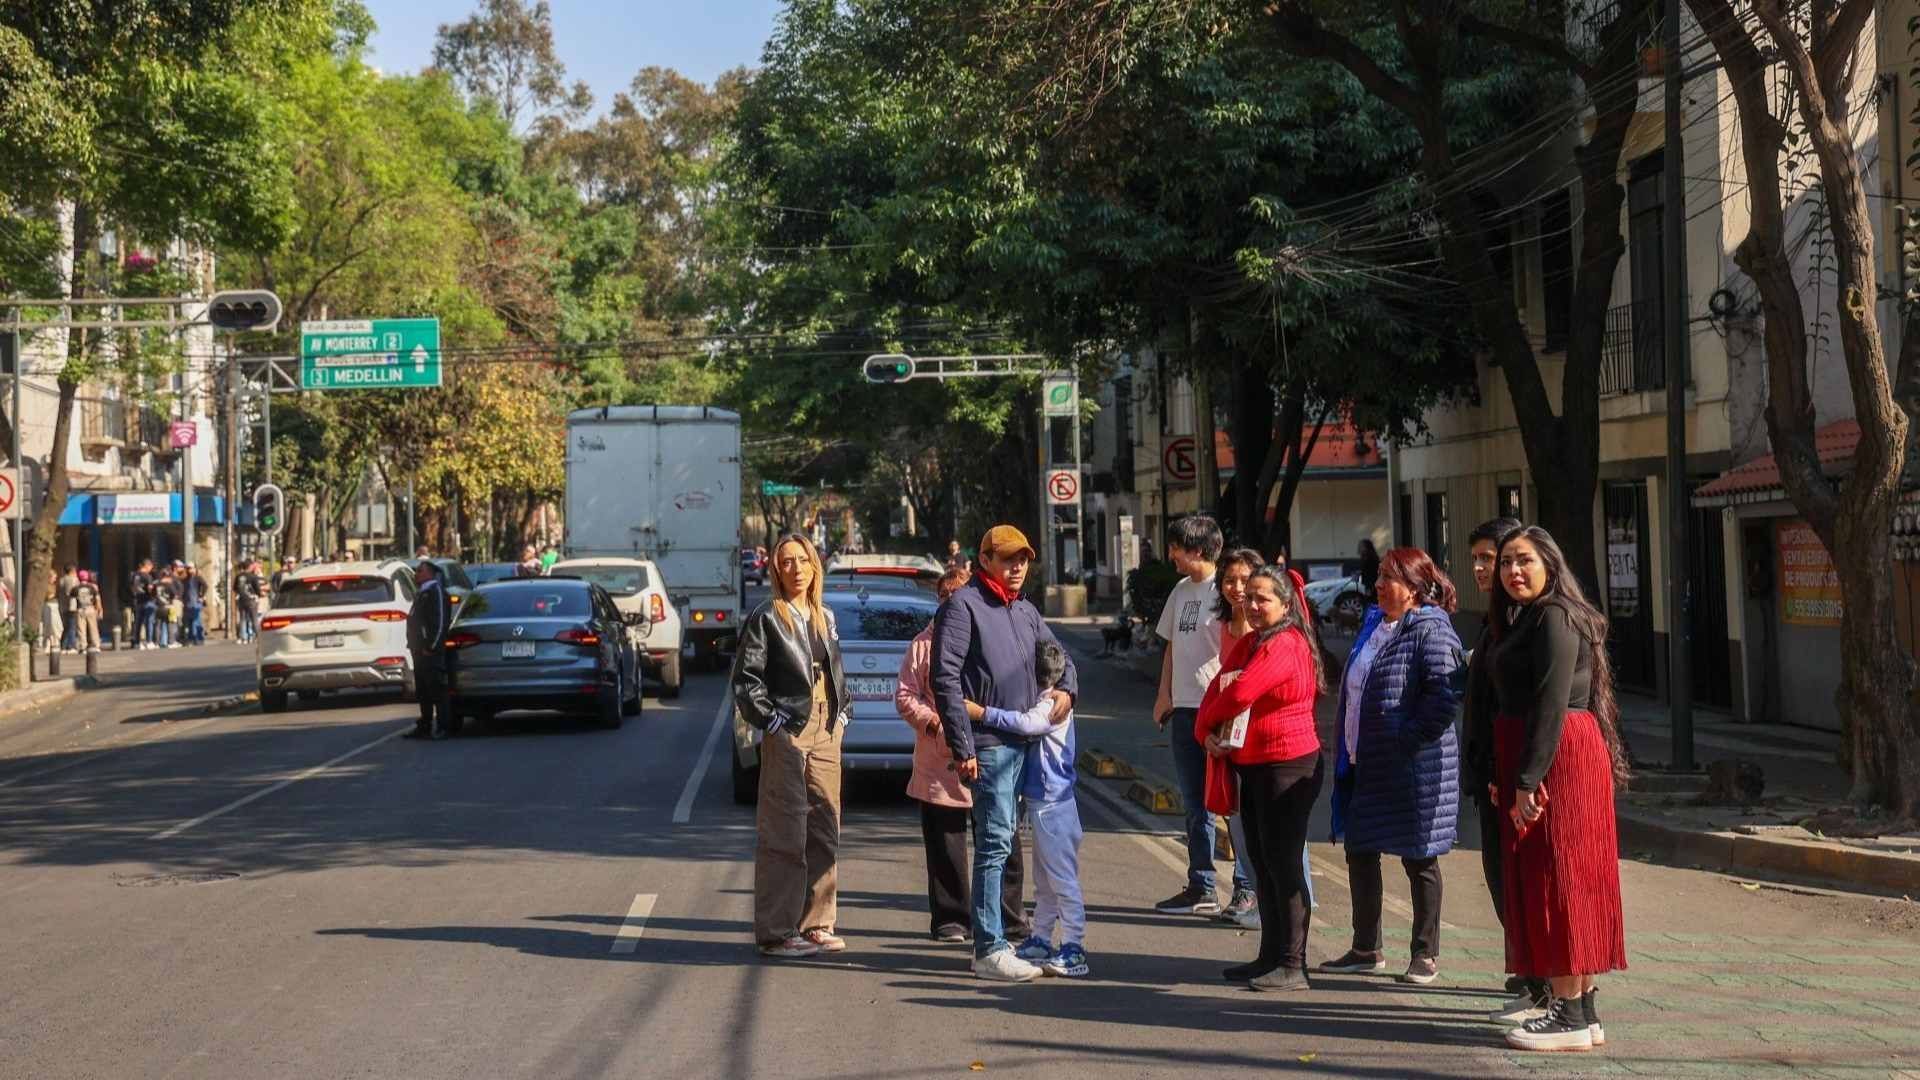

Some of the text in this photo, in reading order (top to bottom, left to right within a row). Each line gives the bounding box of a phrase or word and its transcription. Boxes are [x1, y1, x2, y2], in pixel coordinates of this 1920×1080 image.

[325, 336, 378, 352] MONTERREY
[388, 336, 397, 348] 2
[334, 368, 403, 383] MEDELLIN
